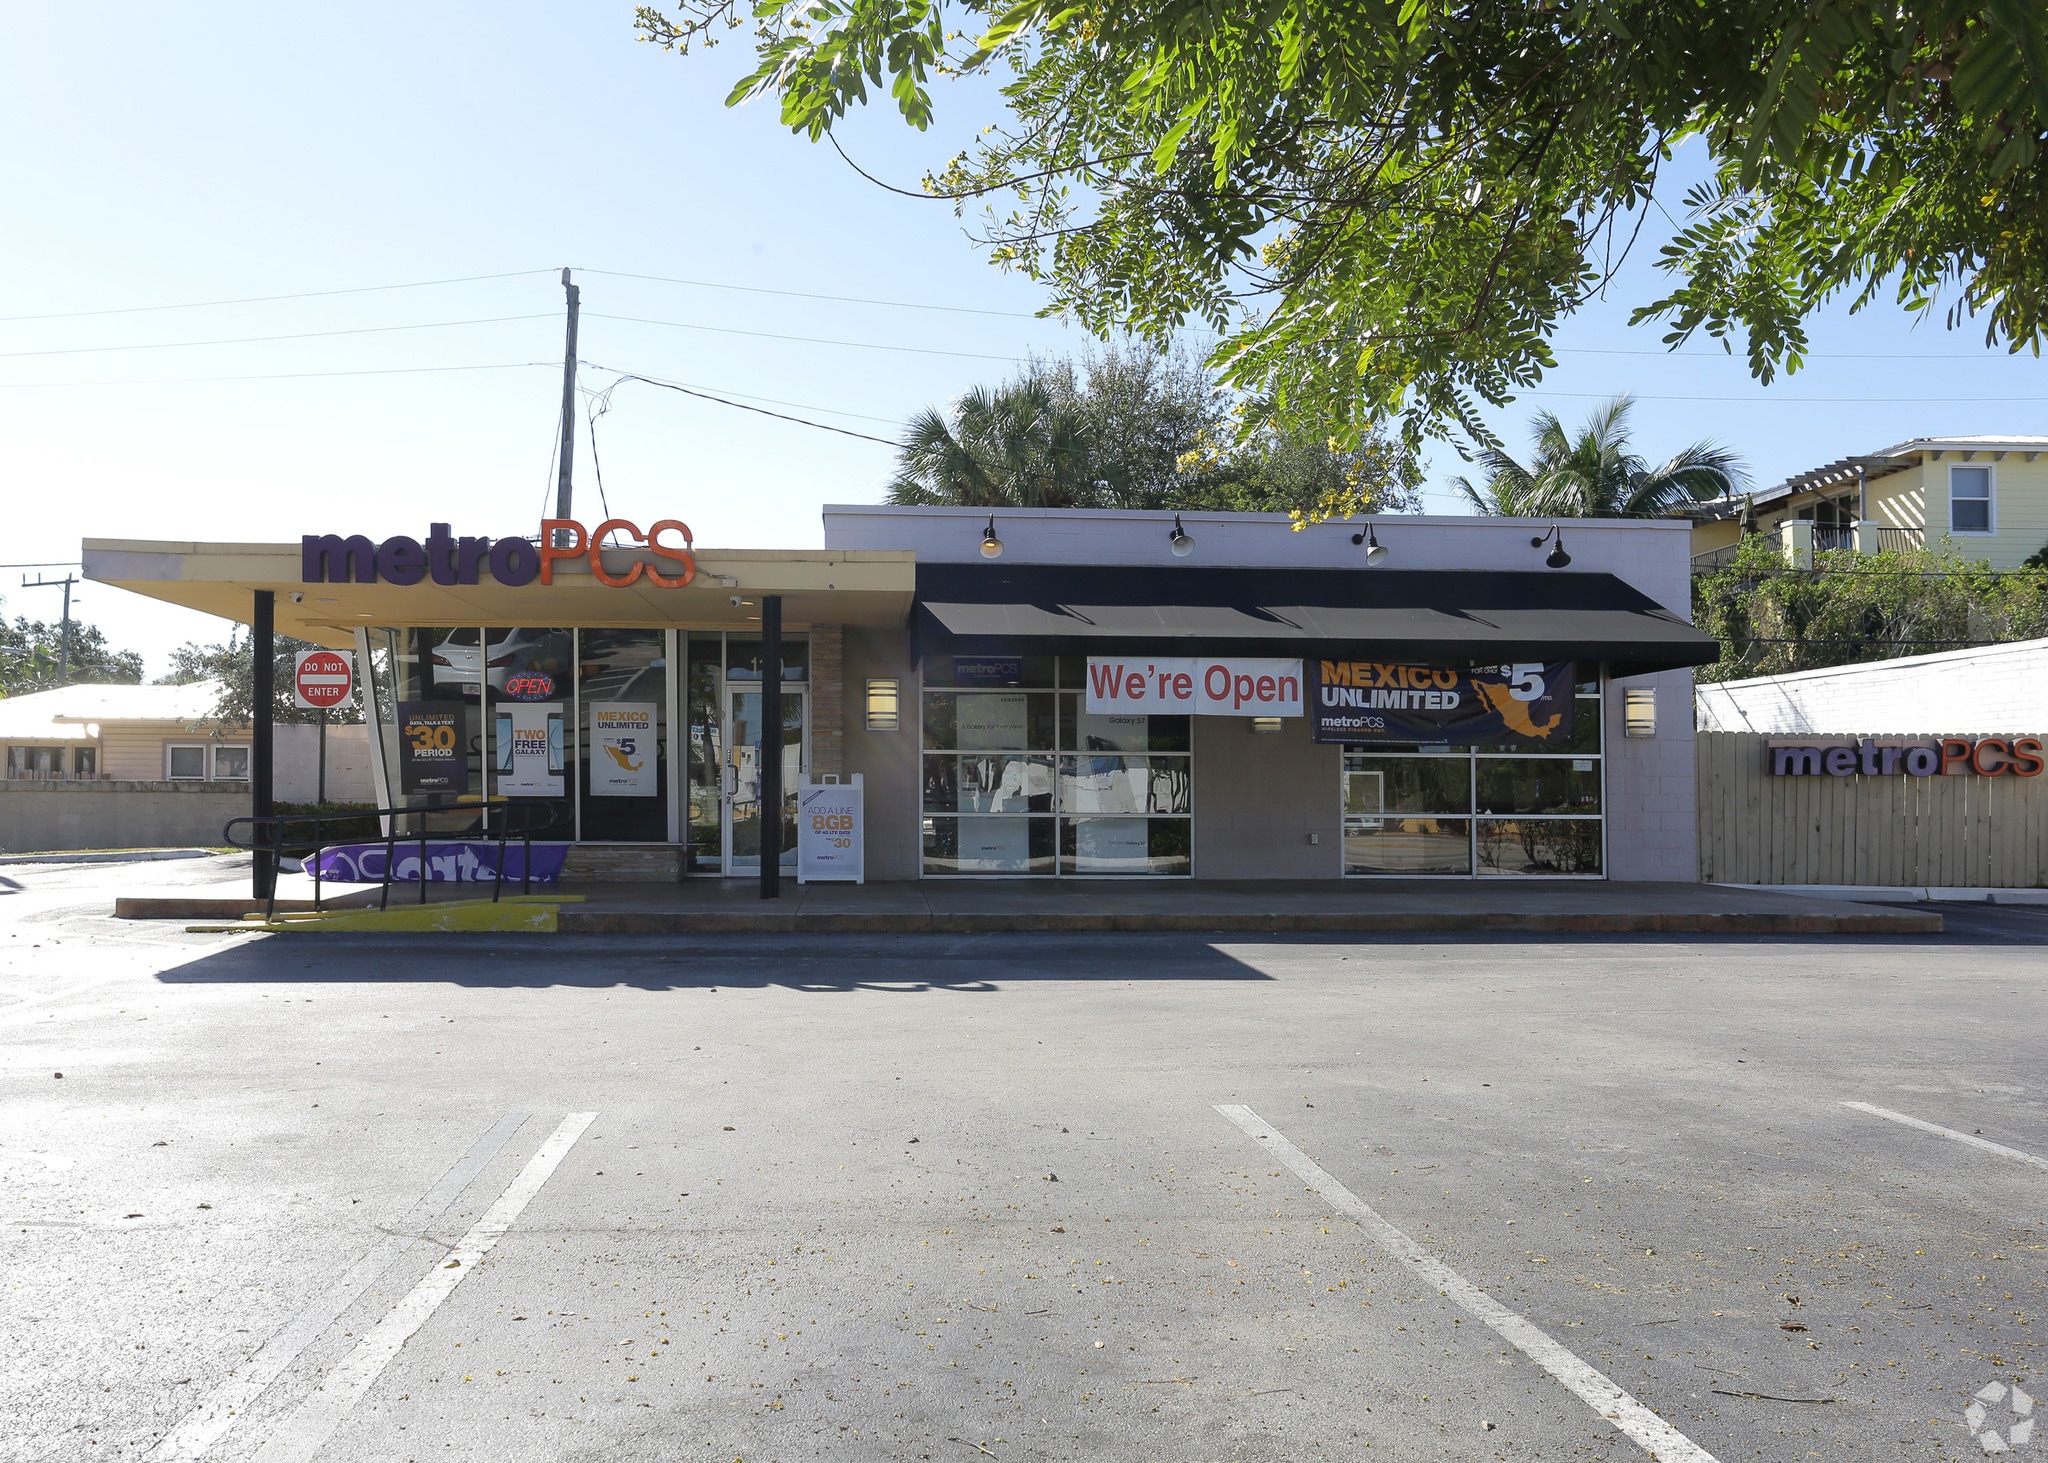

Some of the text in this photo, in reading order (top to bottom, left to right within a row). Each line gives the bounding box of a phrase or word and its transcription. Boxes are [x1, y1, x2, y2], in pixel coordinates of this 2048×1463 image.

[302, 519, 695, 588] metroPCS
[304, 662, 343, 672] DO NOT
[957, 663, 1018, 674] metroPCS
[1321, 660, 1458, 690] MEXICO
[506, 678, 552, 694] OPEN
[1089, 664, 1299, 710] We're Open
[1501, 662, 1545, 702] $5
[308, 687, 339, 697] ENTER
[1321, 687, 1460, 710] UNLIMITED
[597, 711, 650, 722] MEXICO
[1109, 716, 1145, 726] Galaxy S7
[1321, 716, 1384, 728] metroPCS
[597, 721, 649, 730] UNLIMITED
[404, 725, 456, 750] $30
[514, 729, 546, 740] TWO
[514, 740, 546, 749] FREE
[616, 738, 636, 756] $5
[414, 748, 453, 757] PERIOD
[1774, 738, 2044, 778] metroPCS
[812, 815, 854, 830] 8GB
